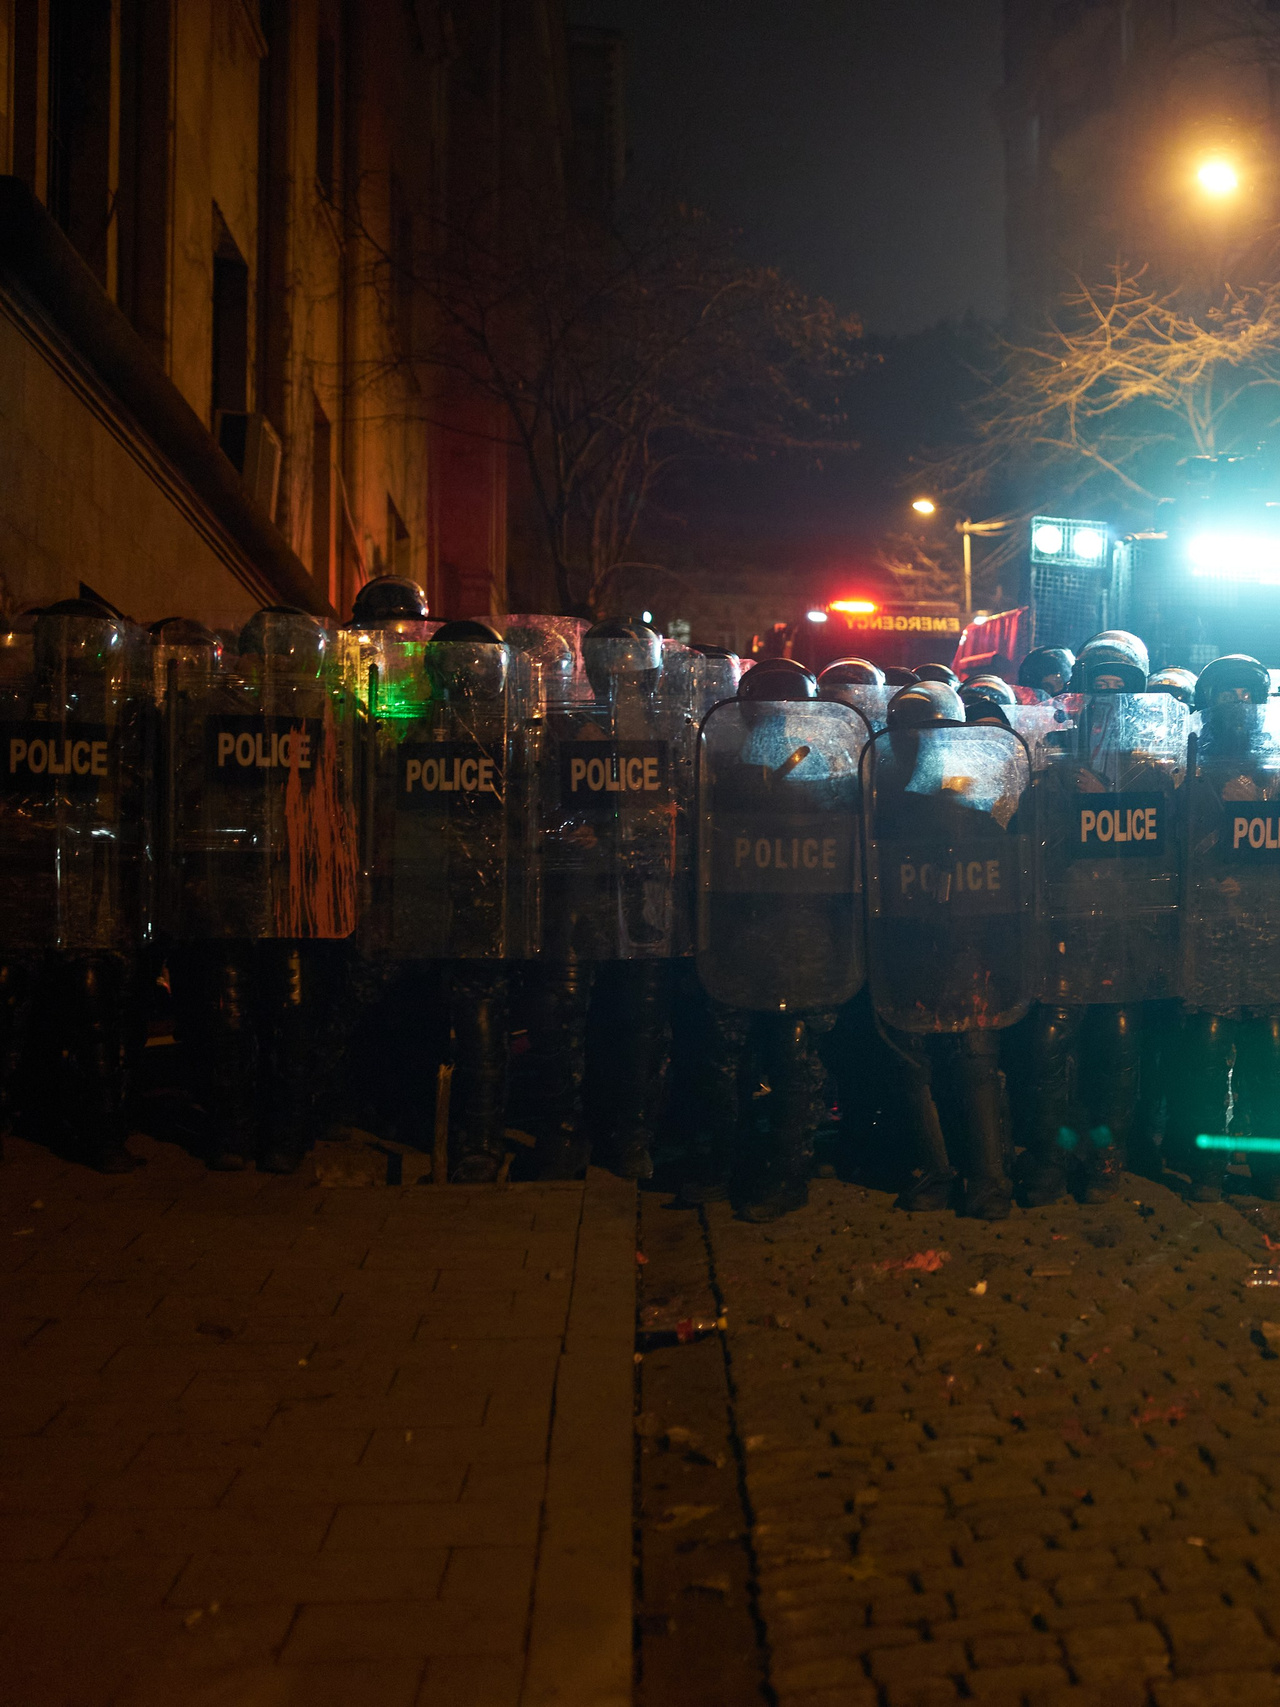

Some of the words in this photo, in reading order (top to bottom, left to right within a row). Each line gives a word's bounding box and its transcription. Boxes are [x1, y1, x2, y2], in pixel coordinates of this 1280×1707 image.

[9, 738, 108, 776] POLICE
[217, 732, 311, 769] POLICE
[405, 757, 494, 793] POLICE
[570, 757, 660, 792] POLICE
[1081, 808, 1157, 842] POLICE
[735, 838, 837, 869] POLICE
[900, 860, 1000, 894] POICE
